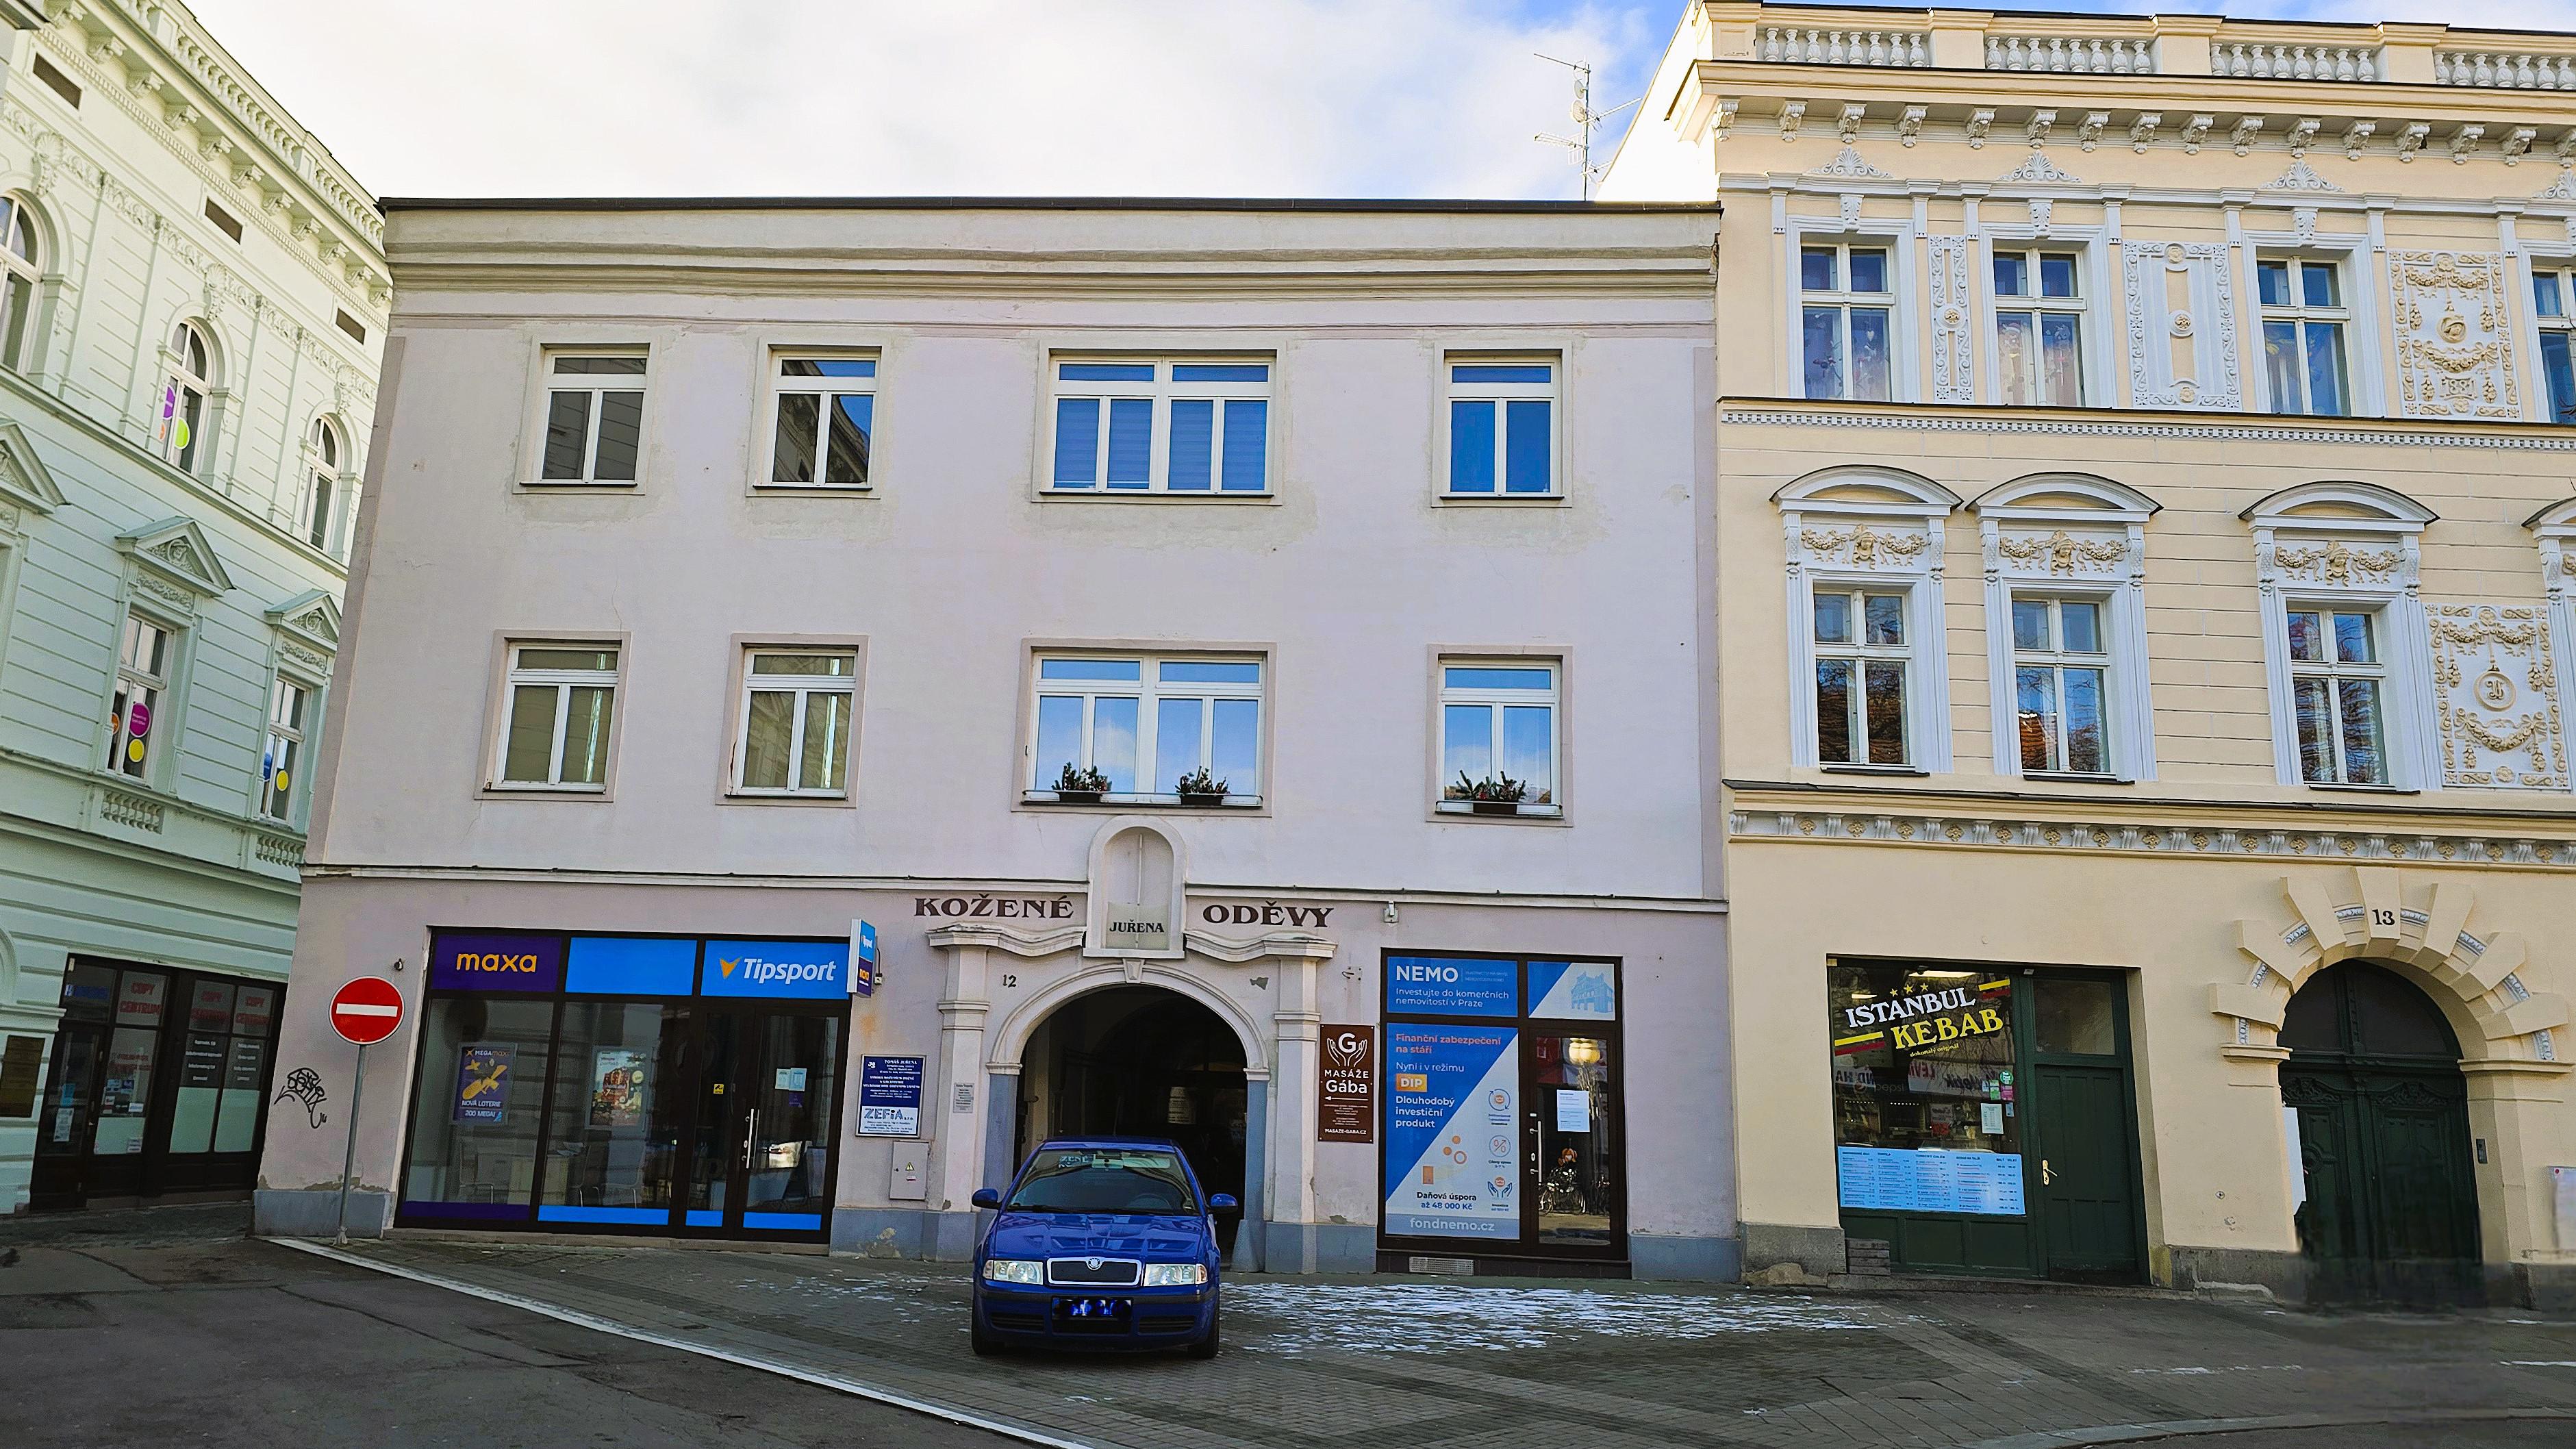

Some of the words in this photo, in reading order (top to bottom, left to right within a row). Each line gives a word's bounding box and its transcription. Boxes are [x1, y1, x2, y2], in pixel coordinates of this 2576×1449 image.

[914, 894, 1074, 918] KOŽENÉ
[1203, 900, 1334, 928] ODĚVY
[2372, 909, 2395, 925] 13
[1109, 919, 1165, 933] JUŘENA
[456, 953, 537, 972] maxa
[744, 958, 837, 985] Tipsport
[1396, 966, 1459, 983] NEMO
[1002, 974, 1017, 988] 12
[1396, 988, 1439, 998] Investujte
[1442, 989, 1454, 997] do
[1456, 990, 1509, 999] komerčních
[1459, 999, 1483, 1007] Praze
[1845, 987, 1976, 1028] ISTANBUL
[1891, 1009, 2004, 1049] KEBAB
[1338, 1033, 1356, 1053] G
[1396, 1033, 1437, 1043] Finanční
[1440, 1035, 1502, 1046] zabezpečení
[1411, 1045, 1432, 1053] stáří
[1324, 1068, 1369, 1079] MASÁŽE
[1396, 1062, 1417, 1072] Nyní
[1432, 1063, 1465, 1072] režimu
[1326, 1079, 1367, 1094] Gába
[1400, 1078, 1424, 1087] DIP
[1396, 1096, 1455, 1107] Dlouhodobý
[1396, 1107, 1443, 1117] investiční
[1396, 1119, 1435, 1128] produkt
[1417, 1192, 1447, 1200] Daňová
[1449, 1193, 1477, 1202] úspora
[1409, 1218, 1495, 1231] fondnemo.cz
